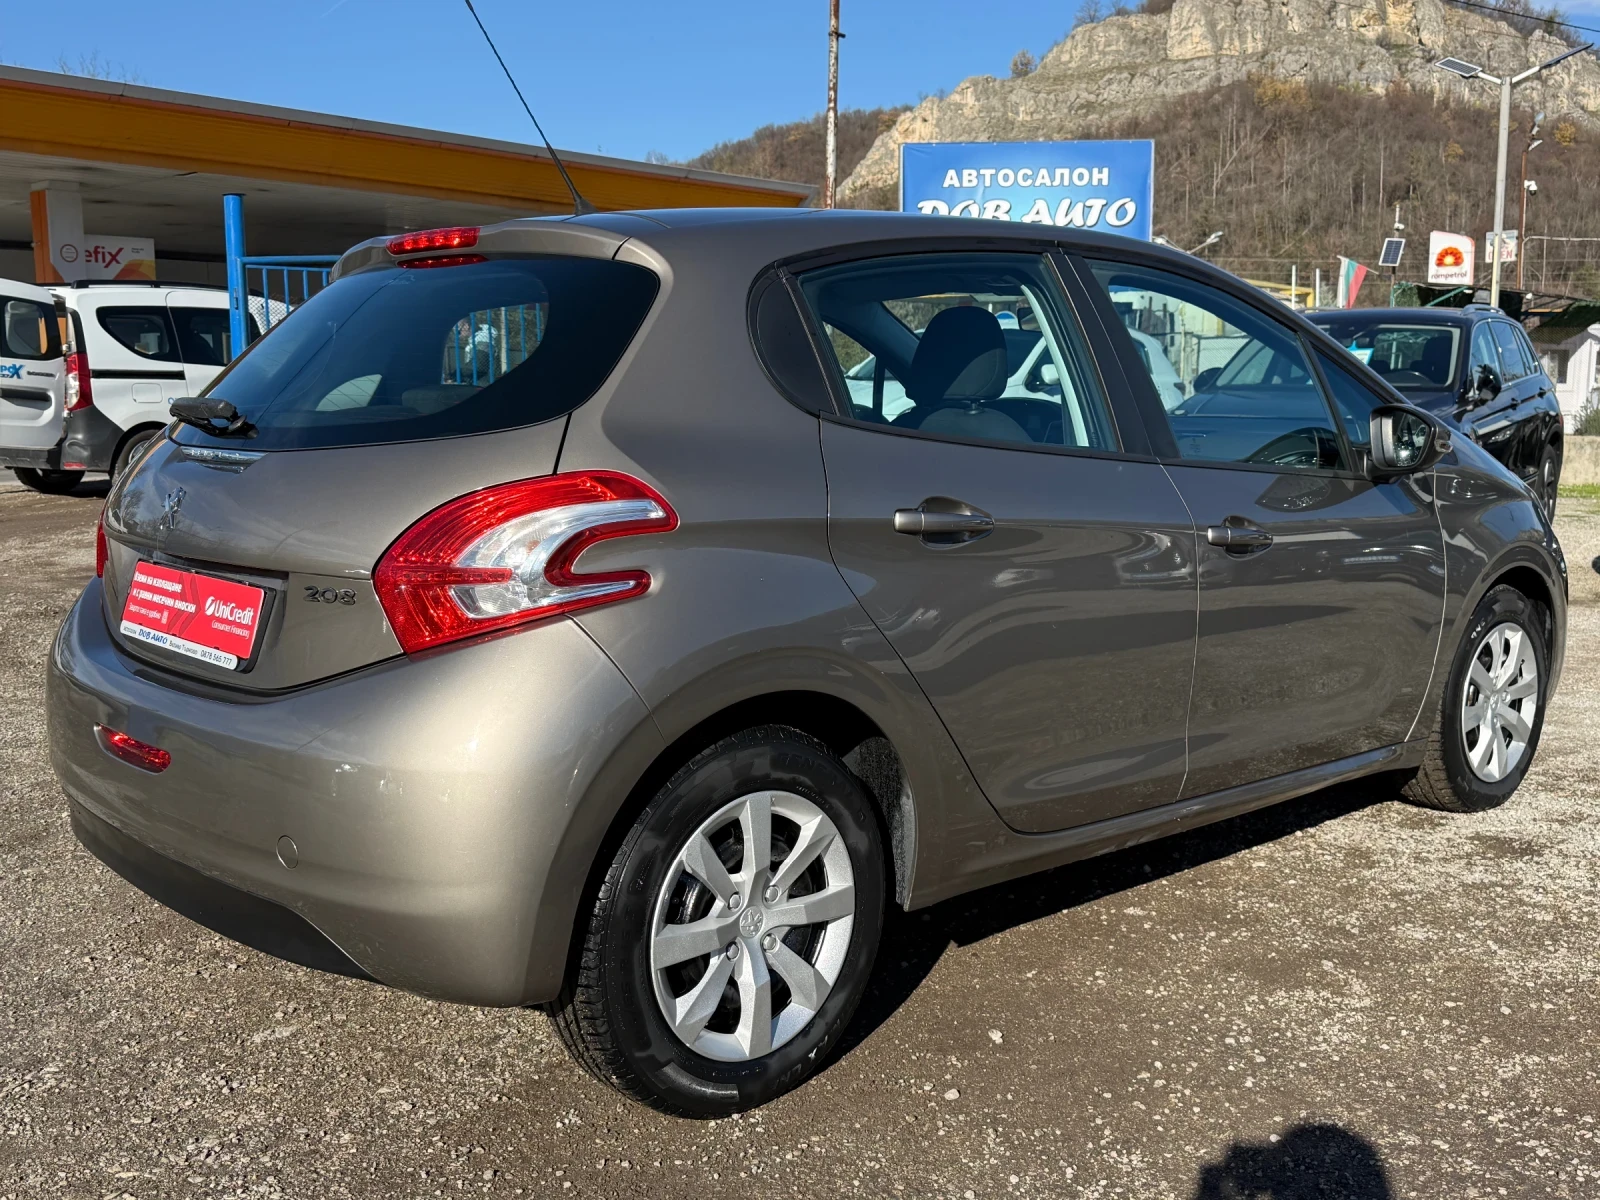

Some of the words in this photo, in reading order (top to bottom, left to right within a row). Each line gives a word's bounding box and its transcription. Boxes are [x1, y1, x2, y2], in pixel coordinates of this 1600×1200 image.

[941, 167, 1110, 188] АВТОСАЛОН
[1431, 271, 1467, 280] rompetrol
[303, 585, 357, 606] 208
[174, 599, 196, 613] вноски
[214, 600, 254, 626] UniCredit
[151, 633, 168, 645] AUTO
[211, 620, 231, 632] Consumer
[231, 625, 250, 640] Financing
[200, 649, 213, 659] 0878
[223, 656, 233, 666] 777
